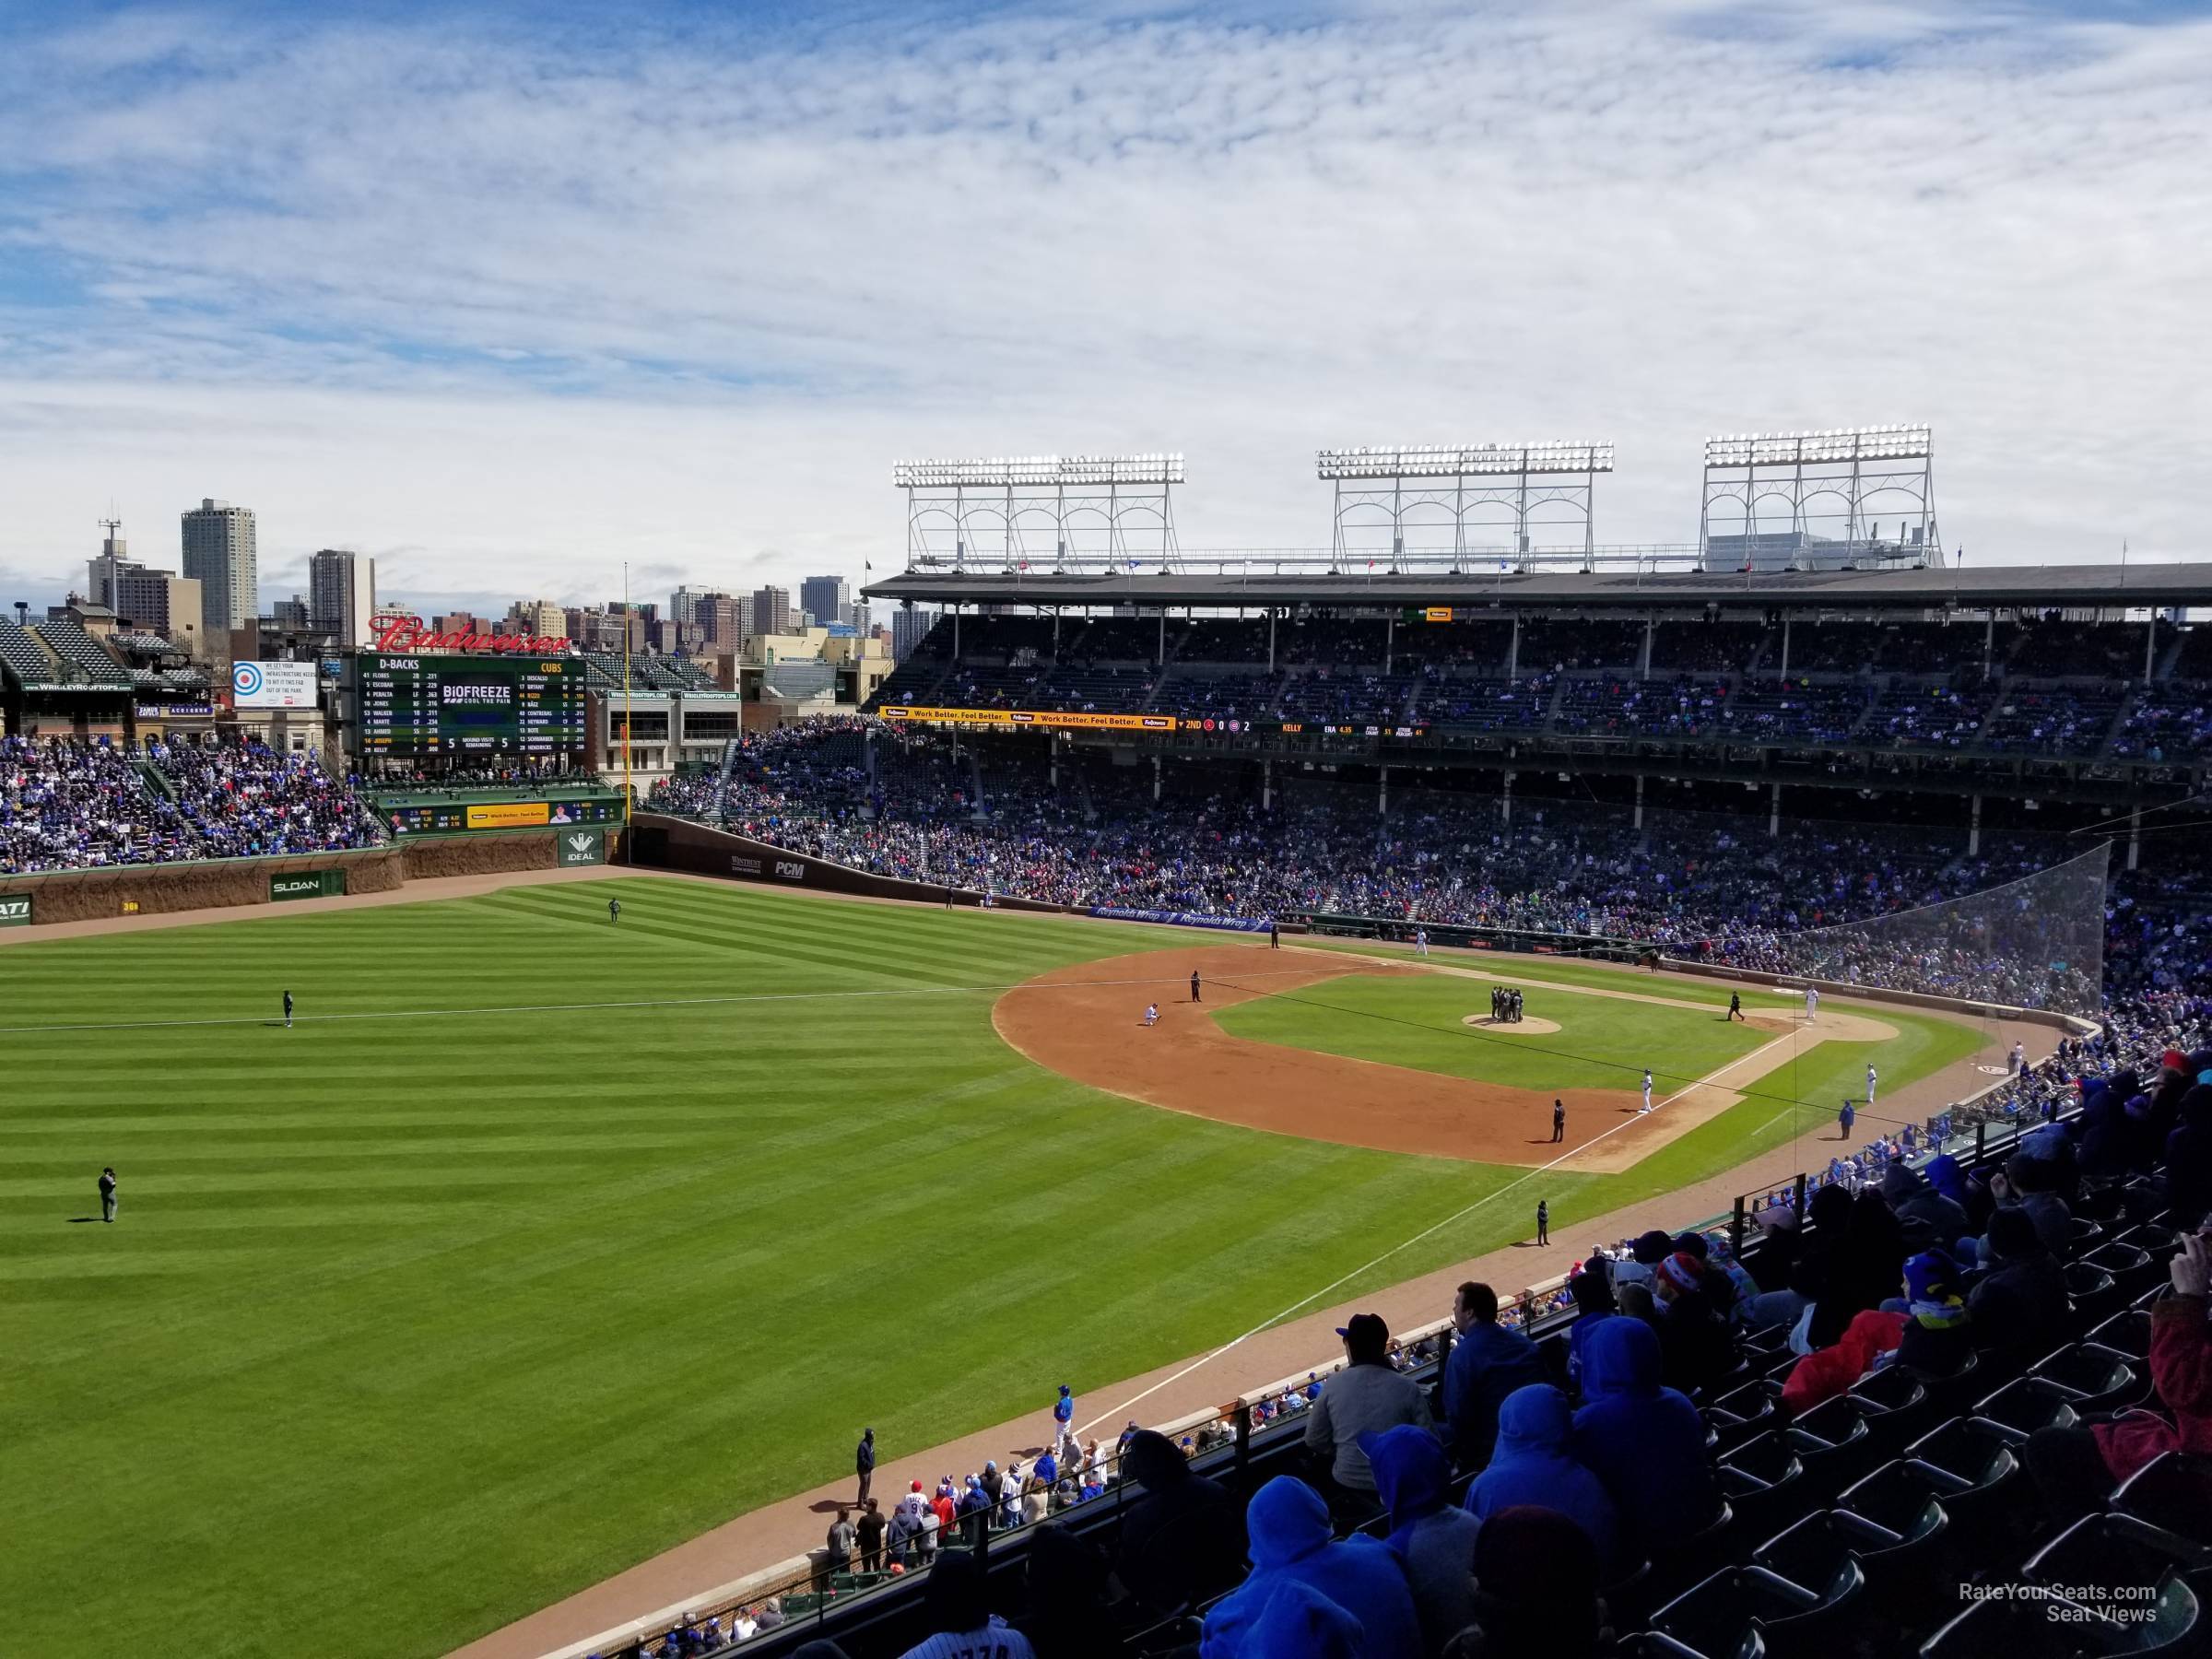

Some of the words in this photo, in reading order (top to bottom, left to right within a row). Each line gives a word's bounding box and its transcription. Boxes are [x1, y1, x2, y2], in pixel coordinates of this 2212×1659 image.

[369, 616, 571, 653] Budweiser
[380, 659, 419, 669] D-BACKS
[541, 664, 561, 672] CUBS
[1062, 716, 1089, 724] Better.
[1109, 717, 1136, 726] Better.
[1186, 720, 1201, 729] 2ND
[1219, 721, 1224, 730] 0
[1244, 722, 1250, 731] 2
[448, 738, 455, 748] 5
[502, 738, 508, 747] 5
[775, 862, 804, 877] PCM
[273, 880, 319, 892] SLOAN
[1096, 907, 1136, 918] Reynolds
[1137, 911, 1160, 922] Wrap
[1180, 914, 1222, 925] Reynolds
[1222, 918, 1246, 929] Wrap
[911, 1503, 917, 1514] 9
